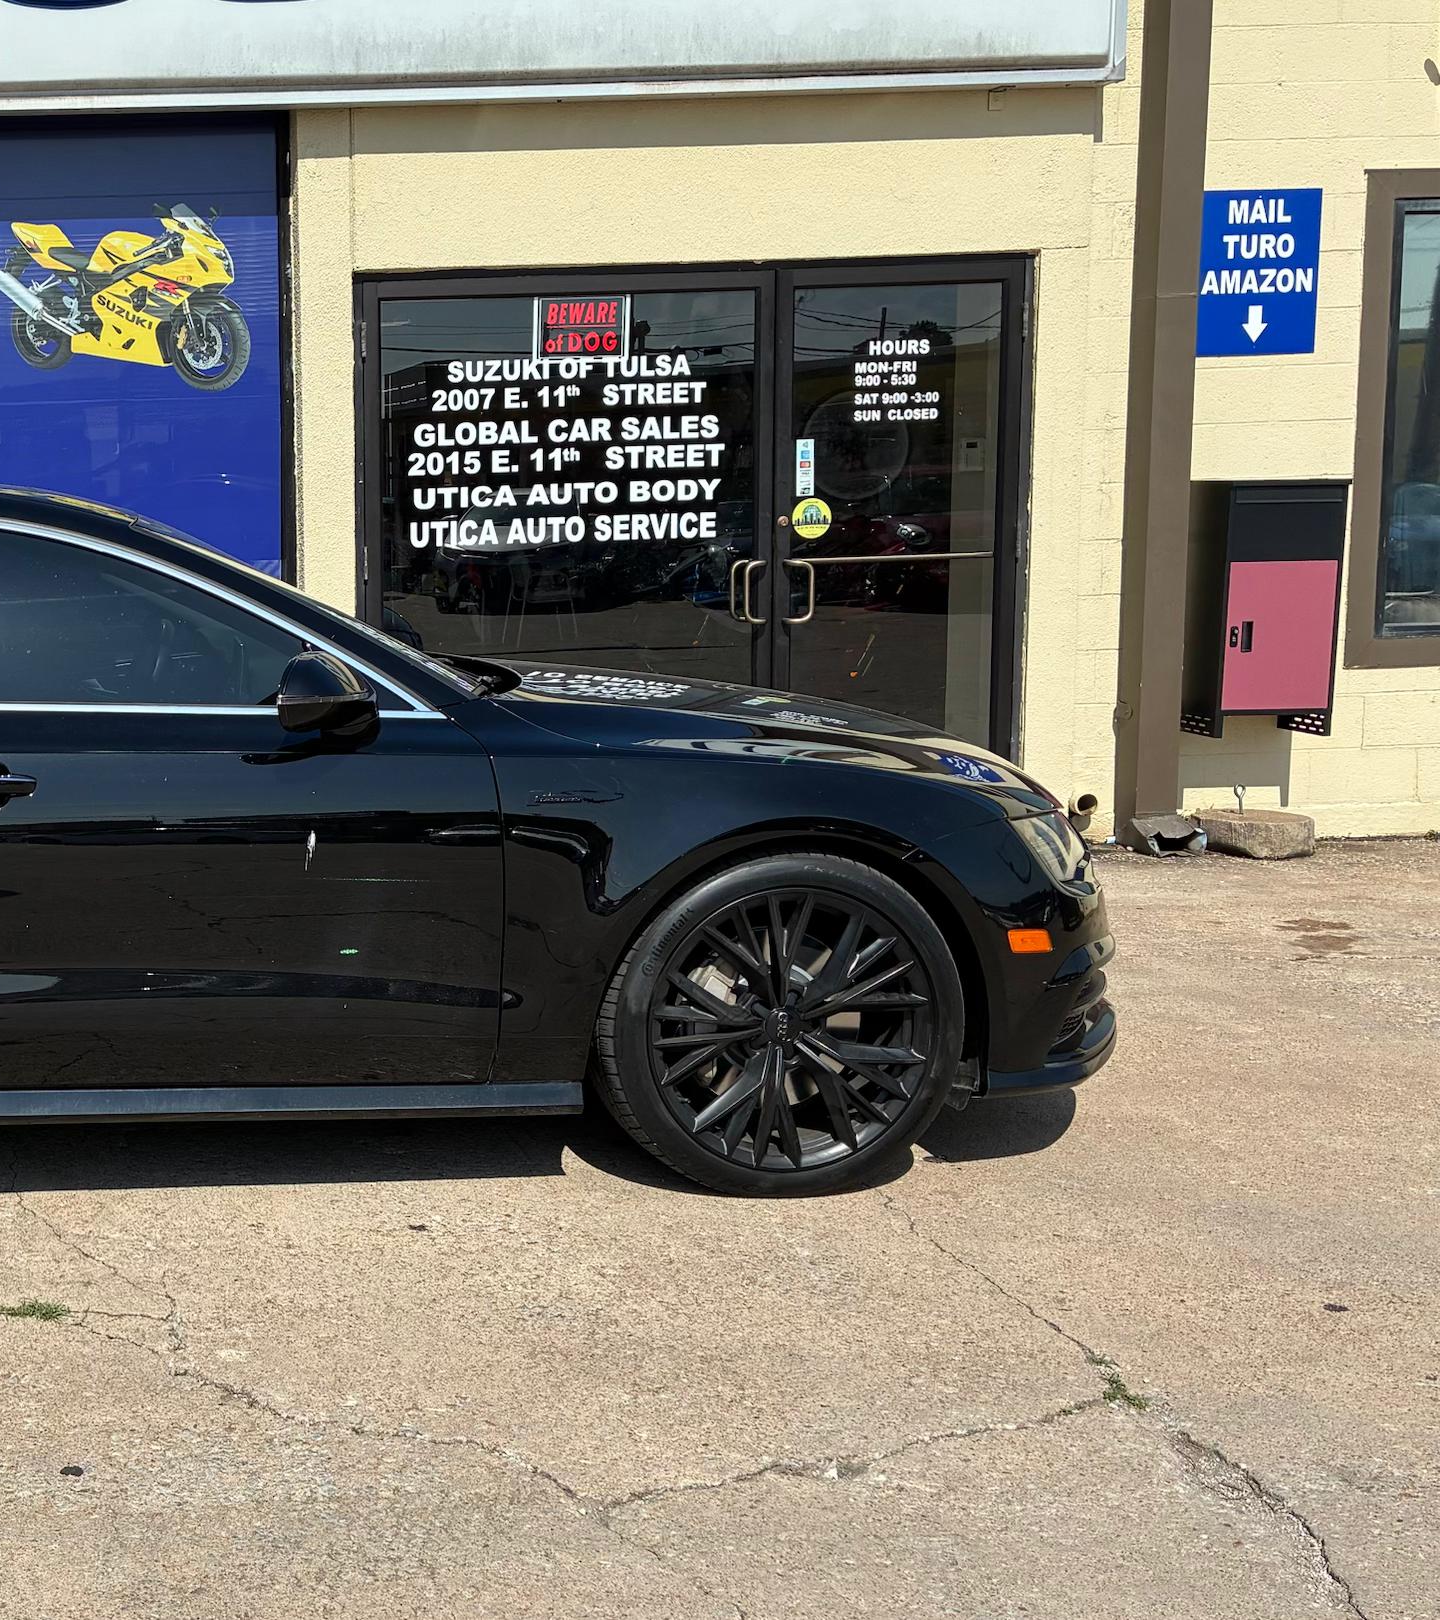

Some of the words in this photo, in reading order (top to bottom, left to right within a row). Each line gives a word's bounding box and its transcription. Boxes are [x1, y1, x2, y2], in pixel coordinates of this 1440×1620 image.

[1228, 198, 1292, 224] MAIL
[1222, 233, 1295, 259] TURO
[1200, 267, 1314, 295] AMAZON
[97, 294, 153, 330] SUZUKI
[546, 301, 618, 325] BEWARE
[544, 333, 564, 353] of
[568, 331, 618, 352] DOG
[868, 339, 930, 356] HOURS
[447, 358, 550, 384] SUZUKI
[559, 357, 593, 379] OF
[602, 354, 692, 379] TULSA
[854, 361, 917, 374] MON-FRI
[854, 375, 881, 387] 9:00
[890, 373, 917, 386] 5:30
[431, 387, 496, 412] 2007
[504, 387, 528, 409] E.
[537, 384, 581, 408] 11th
[602, 381, 707, 406] STREET
[854, 393, 879, 405] SAT
[881, 392, 908, 404] 9:00
[853, 409, 881, 422] SUN
[887, 408, 939, 421] CLOSED
[413, 420, 538, 448] GLOBAL
[547, 417, 612, 443] CAR
[621, 414, 720, 441] SALES
[407, 451, 481, 477] 2015
[491, 449, 519, 473] E.
[530, 447, 581, 472] 11th
[605, 443, 725, 470] STREET
[412, 485, 517, 510] UTICA
[526, 481, 619, 506] AUTO
[629, 478, 722, 503] BODY
[409, 518, 499, 549] UTICA
[506, 515, 586, 545] AUTO
[593, 511, 717, 542] SERVICE
